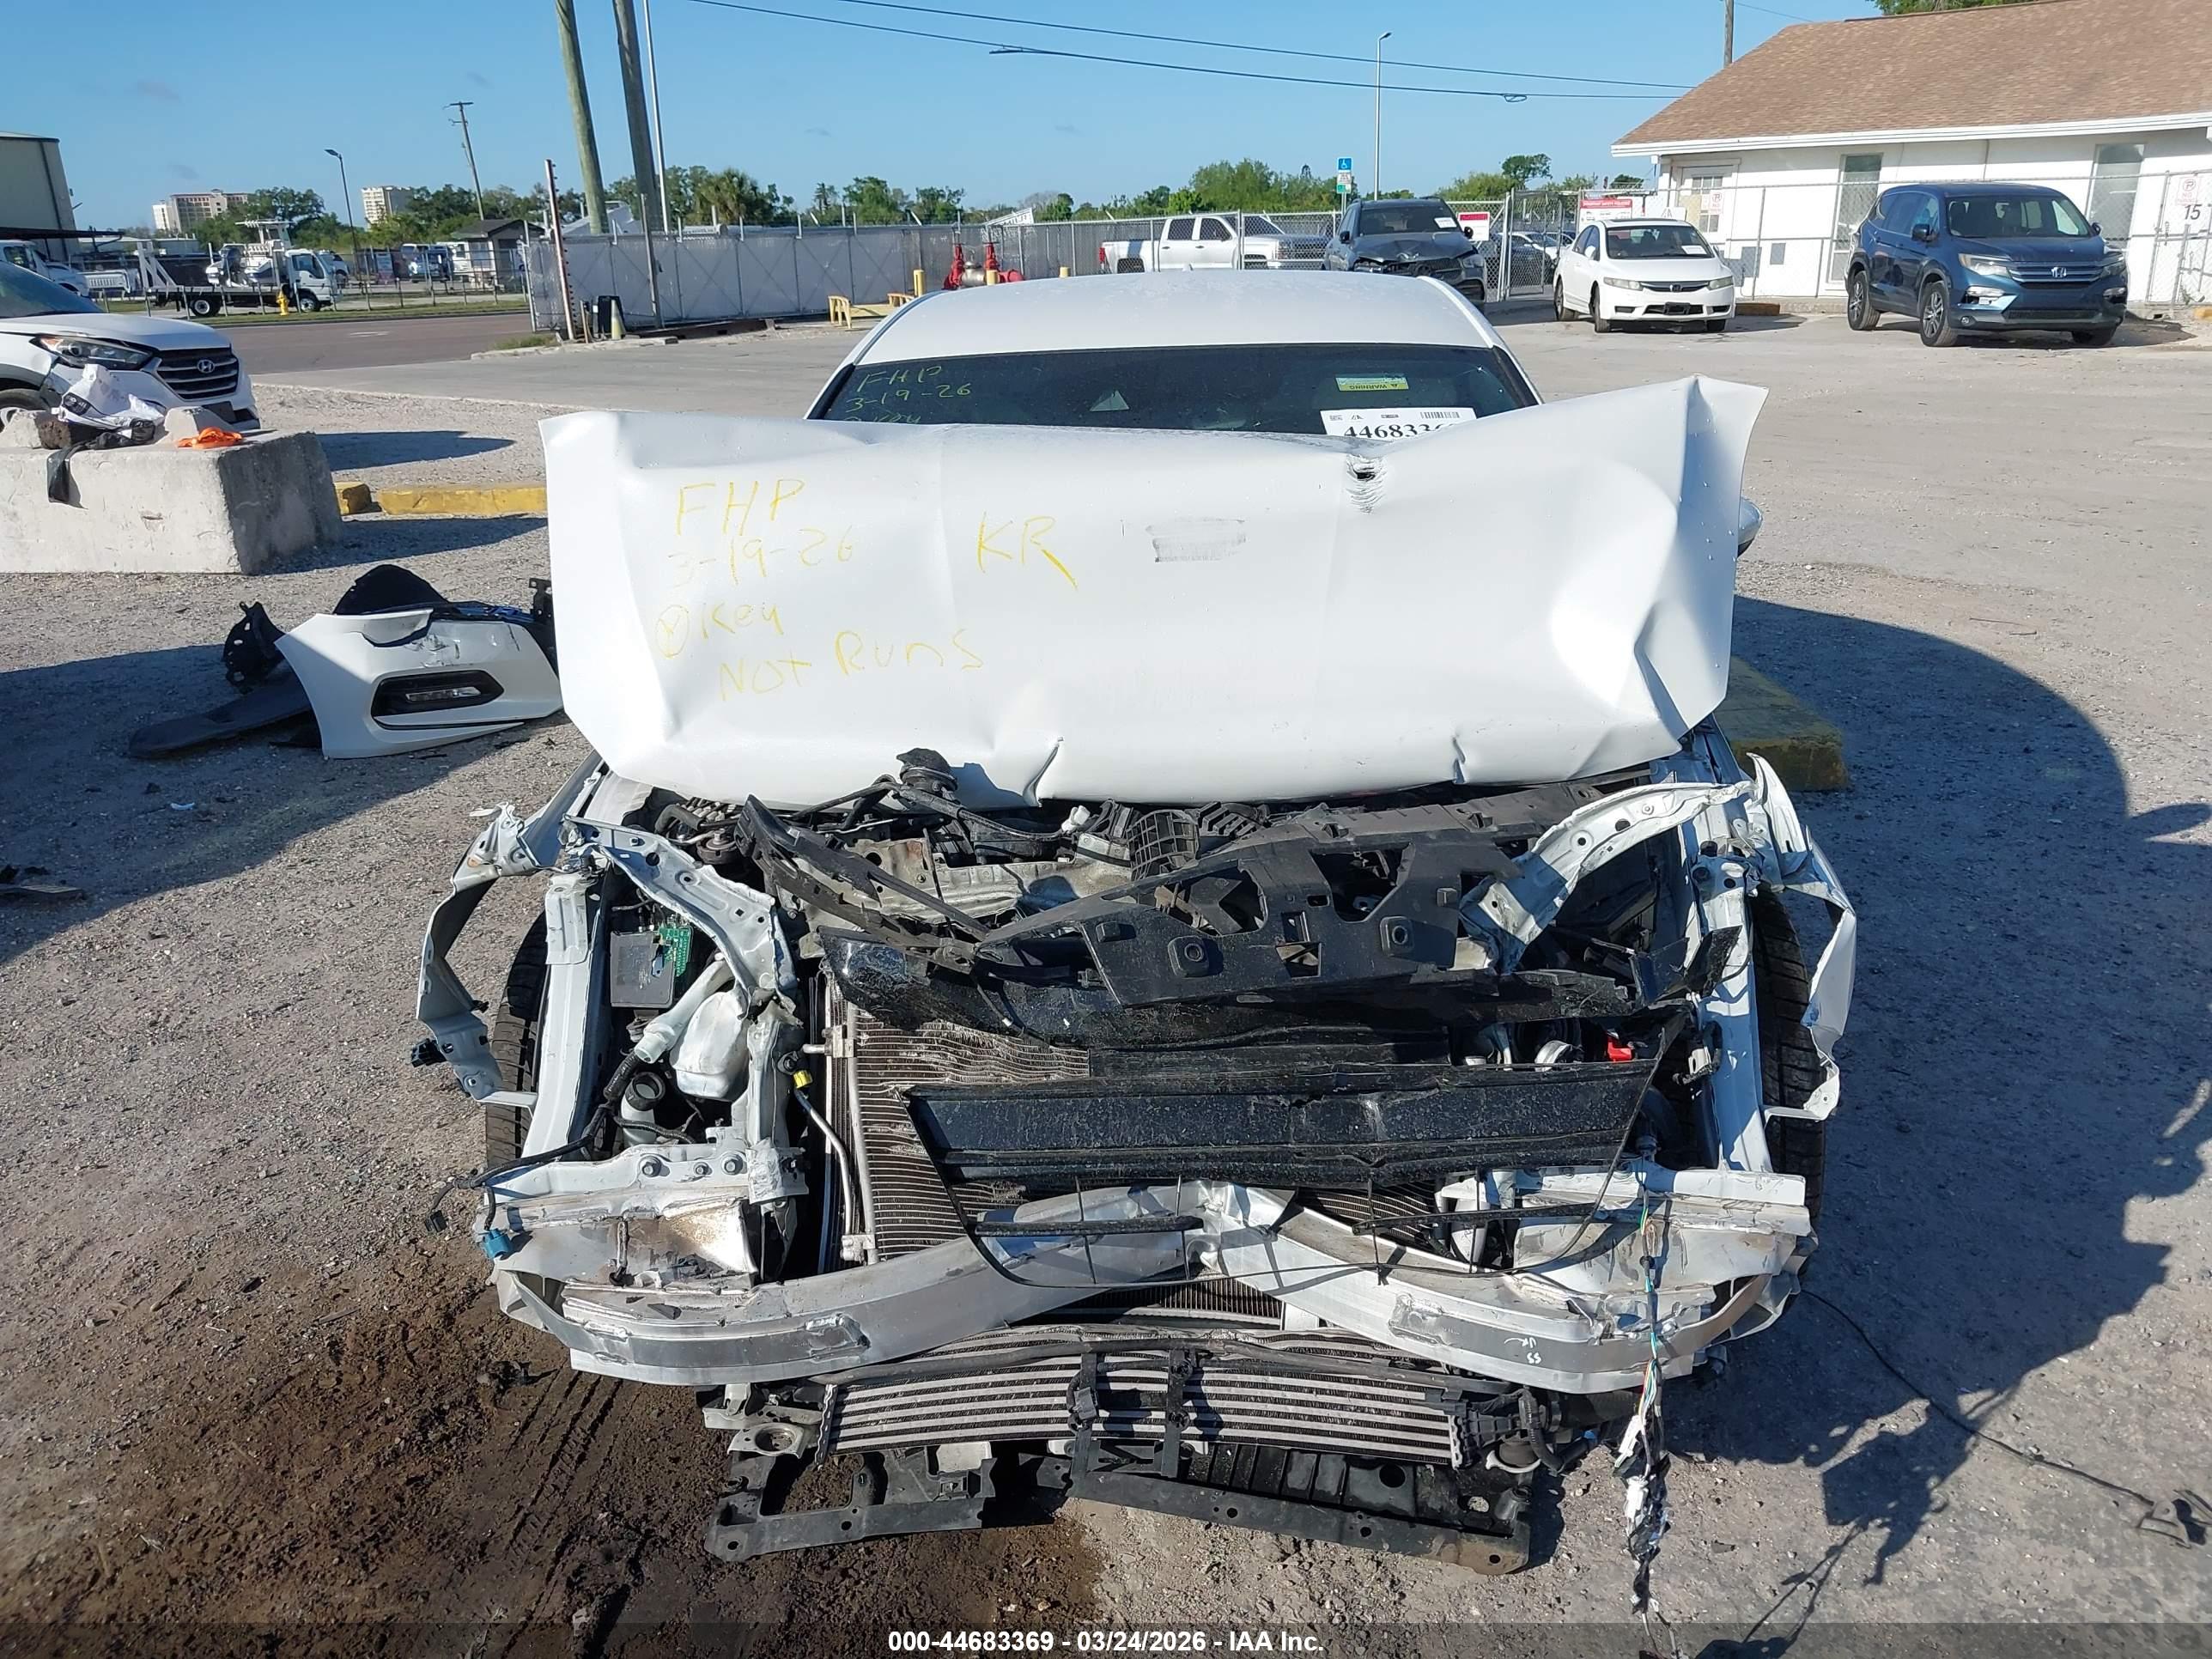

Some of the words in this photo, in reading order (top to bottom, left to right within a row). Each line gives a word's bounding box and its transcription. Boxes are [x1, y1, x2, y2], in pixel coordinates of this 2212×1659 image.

[2184, 204, 2202, 220] 15
[845, 382, 972, 413] 3-19-26
[856, 365, 943, 392] FHP
[676, 478, 805, 536] FHP
[666, 524, 854, 588] 3-19-26
[977, 511, 1079, 590] KR
[701, 601, 785, 640] Key
